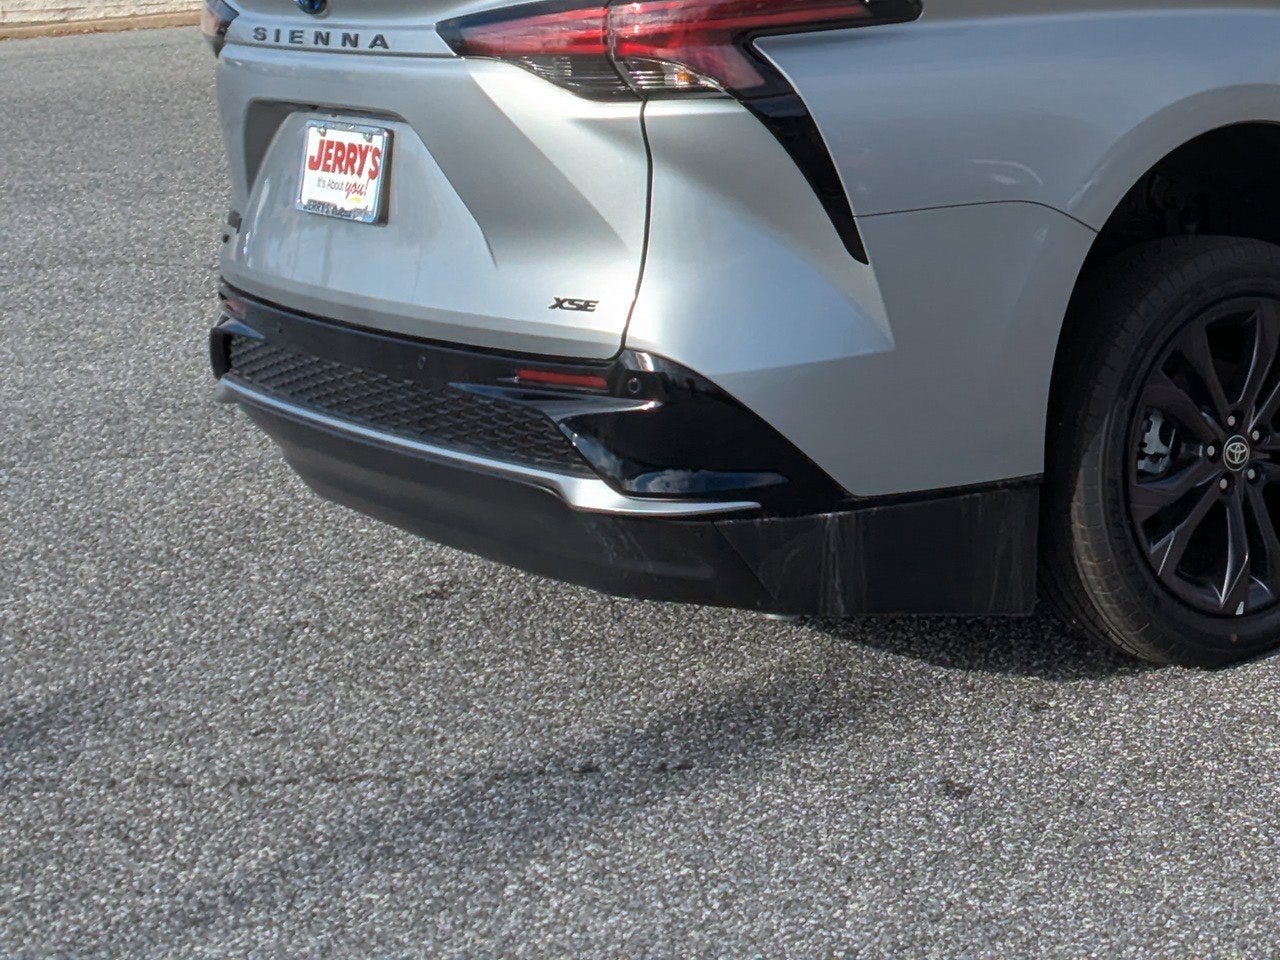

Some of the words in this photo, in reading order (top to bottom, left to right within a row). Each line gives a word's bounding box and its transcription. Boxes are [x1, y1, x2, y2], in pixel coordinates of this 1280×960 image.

[253, 26, 389, 49] SIENNA
[308, 139, 381, 180] JERRY'S
[327, 179, 344, 191] About
[344, 179, 370, 200] you!
[548, 296, 600, 312] XSE
